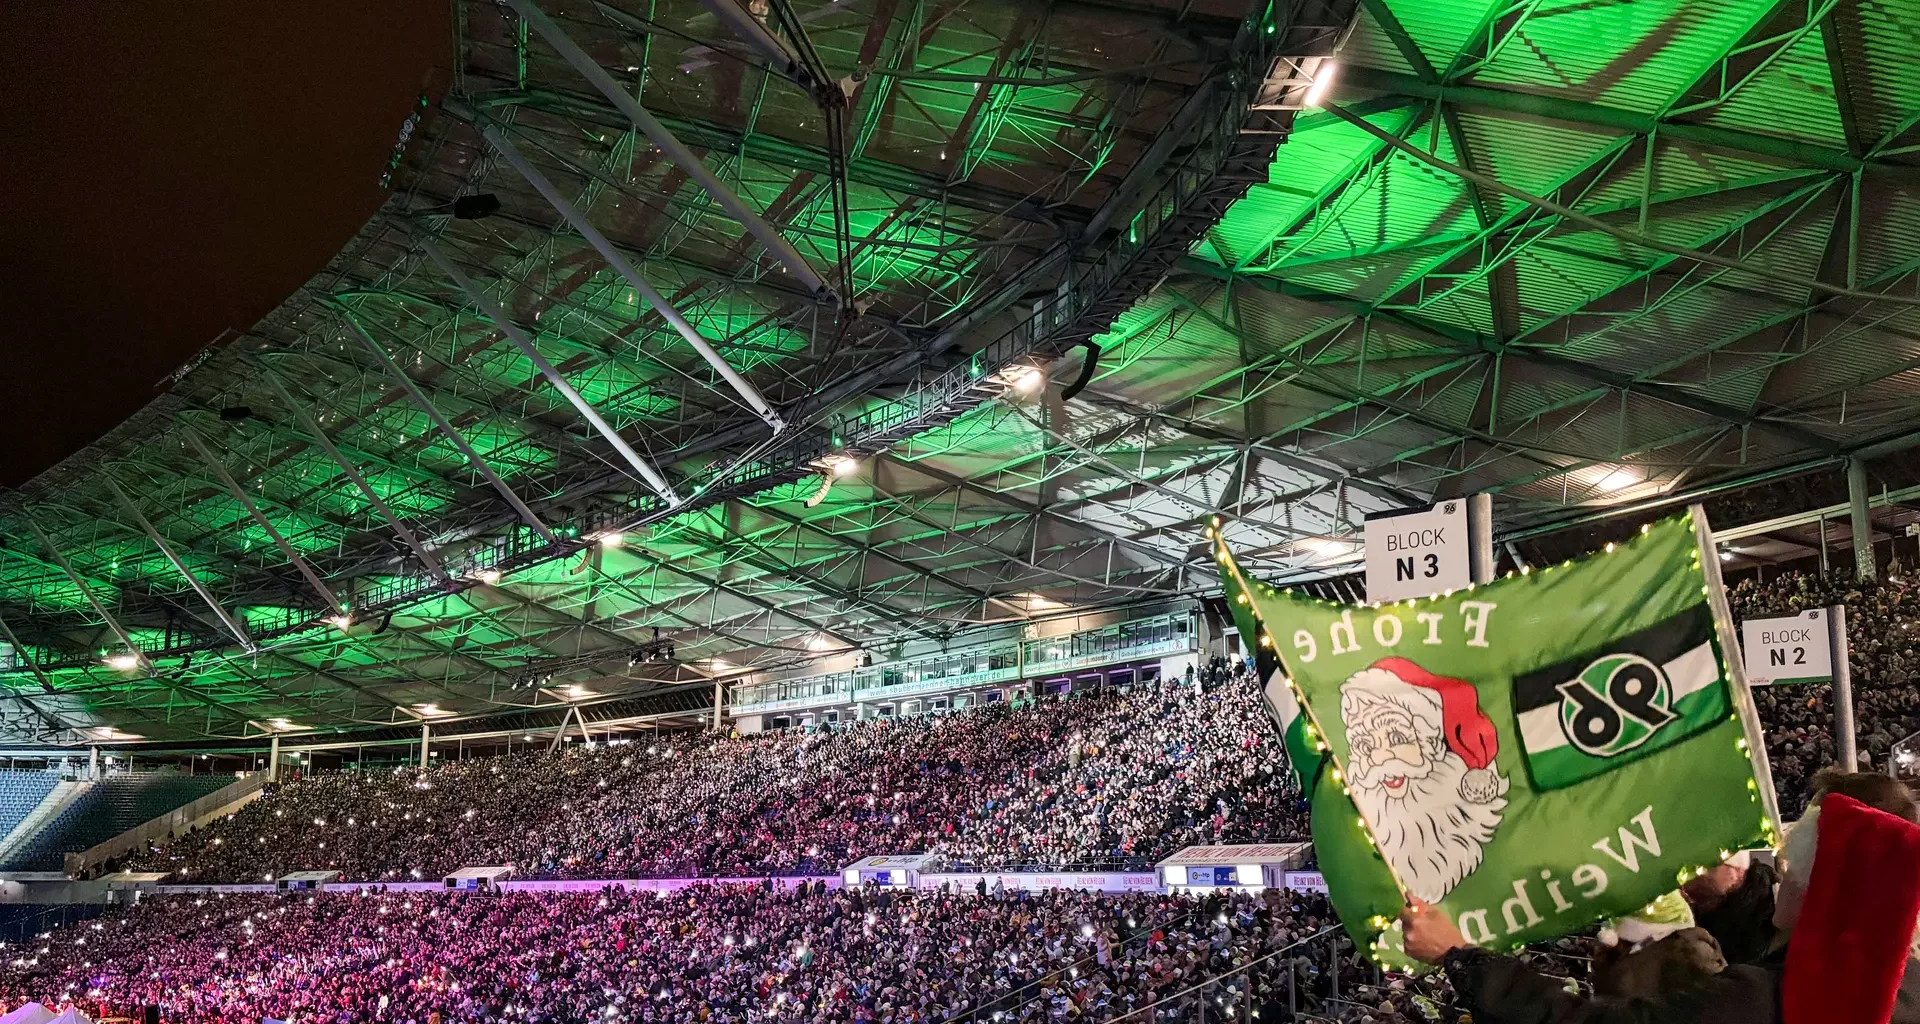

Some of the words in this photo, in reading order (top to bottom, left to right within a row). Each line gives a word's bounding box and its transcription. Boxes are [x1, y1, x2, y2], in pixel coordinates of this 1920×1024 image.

[1443, 502, 1457, 514] 96
[1387, 527, 1446, 552] BLOCK
[1396, 556, 1415, 582] N
[1423, 553, 1439, 578] 3
[1808, 610, 1820, 620] 96
[1762, 628, 1811, 645] BLOCK
[1770, 648, 1786, 667] N
[1792, 646, 1806, 665] 2
